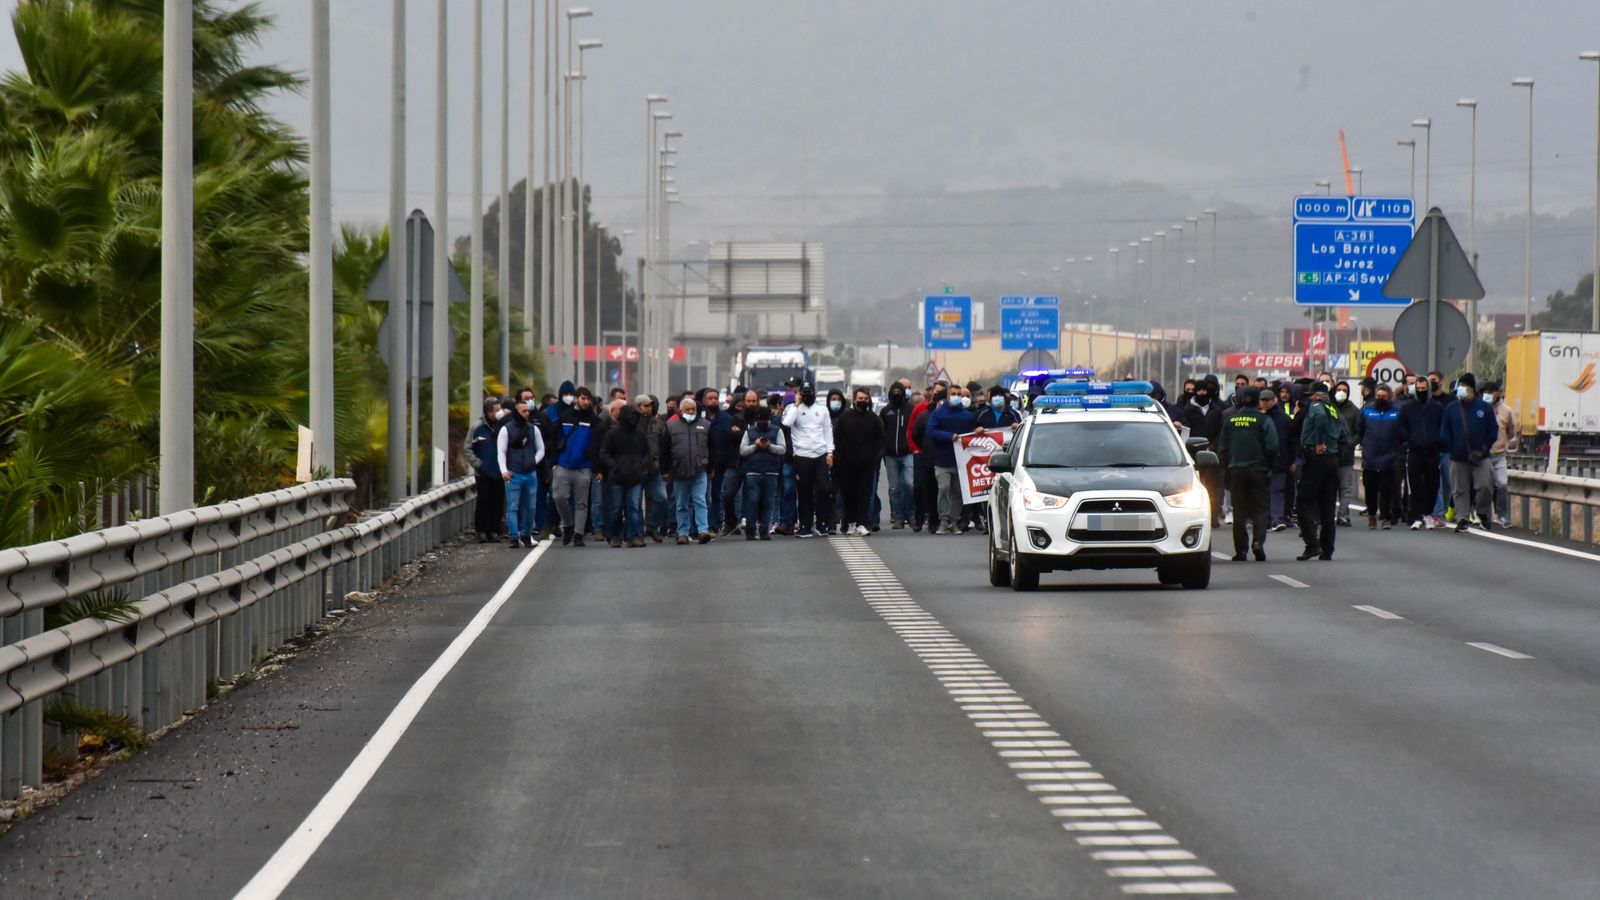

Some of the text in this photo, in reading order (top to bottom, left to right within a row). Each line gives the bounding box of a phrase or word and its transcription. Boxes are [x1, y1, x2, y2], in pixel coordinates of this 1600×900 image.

[1299, 203, 1346, 213] 1000 m
[1381, 204, 1410, 214] 110B
[1336, 231, 1373, 241] A-381
[1312, 243, 1397, 255] Los Barrios
[1335, 258, 1374, 269] Jerez
[1549, 345, 1580, 358] GM
[1255, 355, 1303, 367] CEPSA
[1373, 368, 1405, 383] 100
